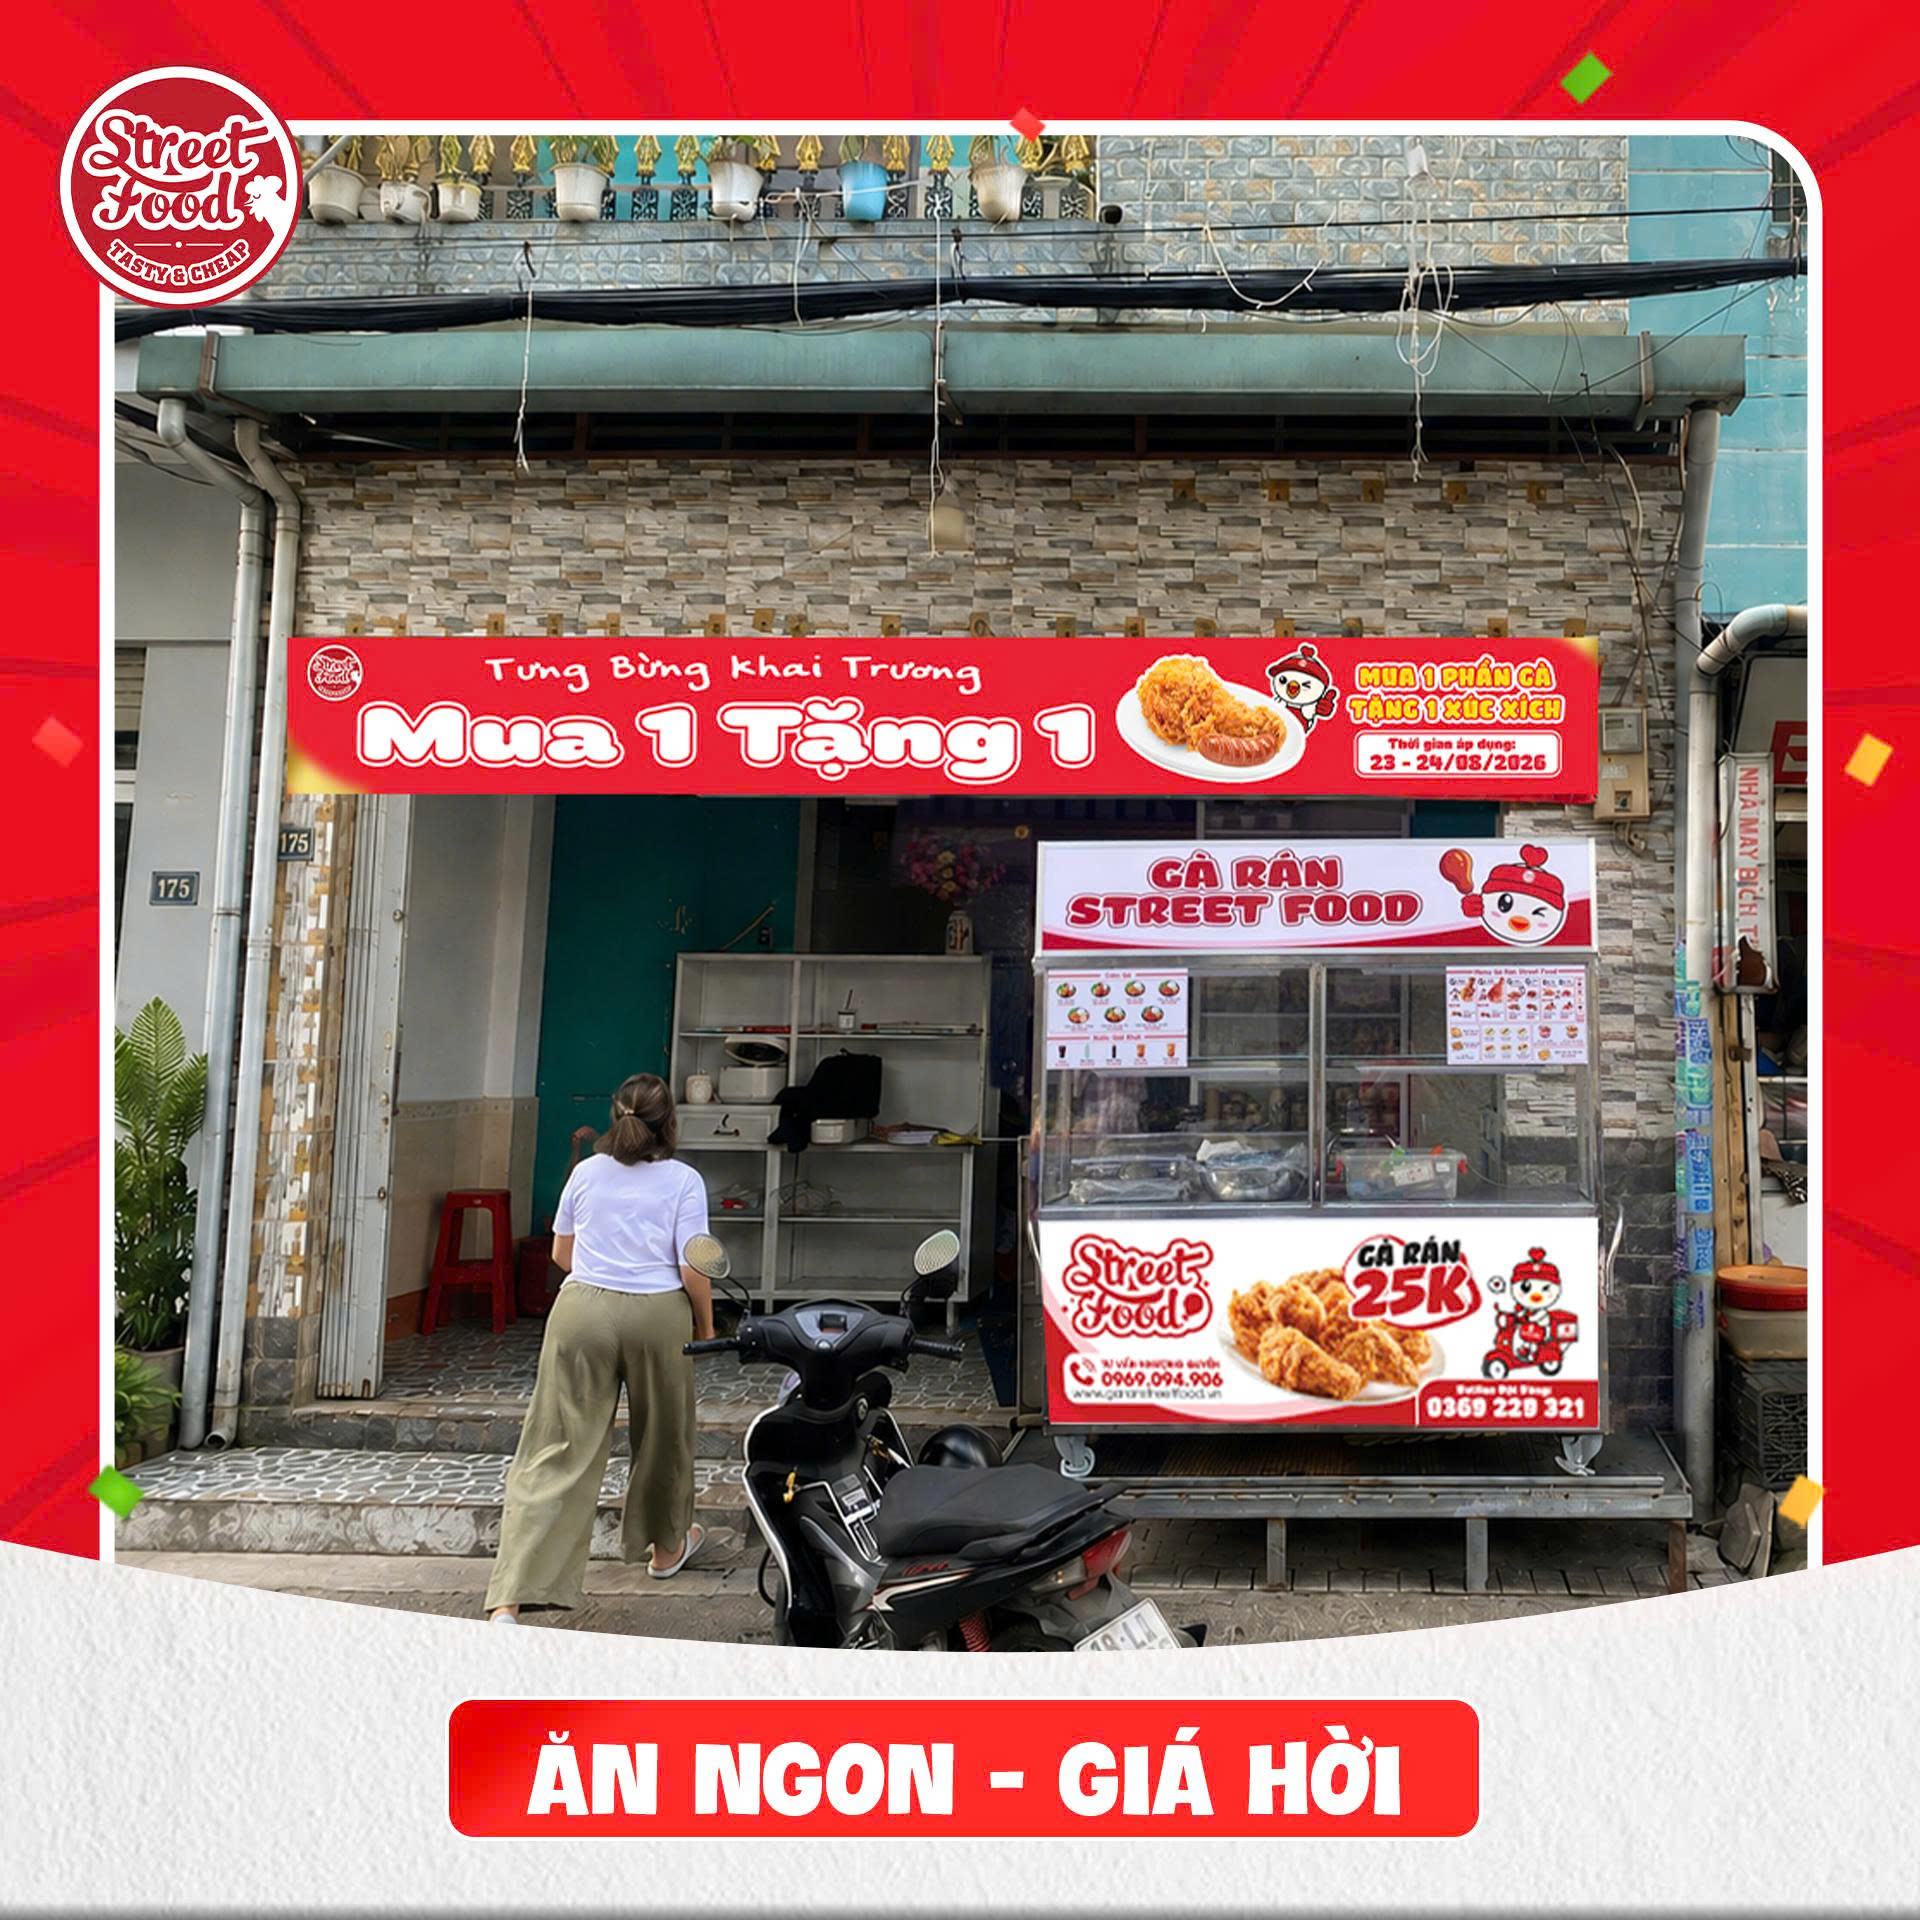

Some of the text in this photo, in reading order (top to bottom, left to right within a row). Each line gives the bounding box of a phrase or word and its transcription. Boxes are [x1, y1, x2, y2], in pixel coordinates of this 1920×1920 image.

[485, 658, 590, 693] Tưng
[610, 652, 711, 691] Bừng
[841, 656, 982, 695] Trương
[1358, 665, 1416, 688] MUA
[1422, 665, 1436, 688] 1
[1518, 660, 1552, 688] GÀ
[1350, 693, 1562, 724] TẶNG 1 XÚC XÍCH
[359, 697, 1094, 783] Mua 1 Tặng 1
[1388, 737, 1419, 750] Thời
[1423, 739, 1453, 752] gian
[1456, 738, 1474, 751] áp
[1370, 754, 1396, 771] 23
[280, 833, 309, 853] 175
[1738, 816, 1759, 860] MAY
[1150, 850, 1341, 890] GÀ RÁN
[158, 878, 190, 899] 175
[1068, 892, 1421, 927] STREET FOOD
[1358, 1235, 1460, 1268] GÀ RÁN
[1070, 1243, 1205, 1296] Street
[1351, 1265, 1467, 1317] 25K
[1080, 1287, 1184, 1331] Food
[1101, 1372, 1224, 1388] 0969.094.906
[1426, 1396, 1487, 1418] 0369
[1543, 1397, 1585, 1419] 321
